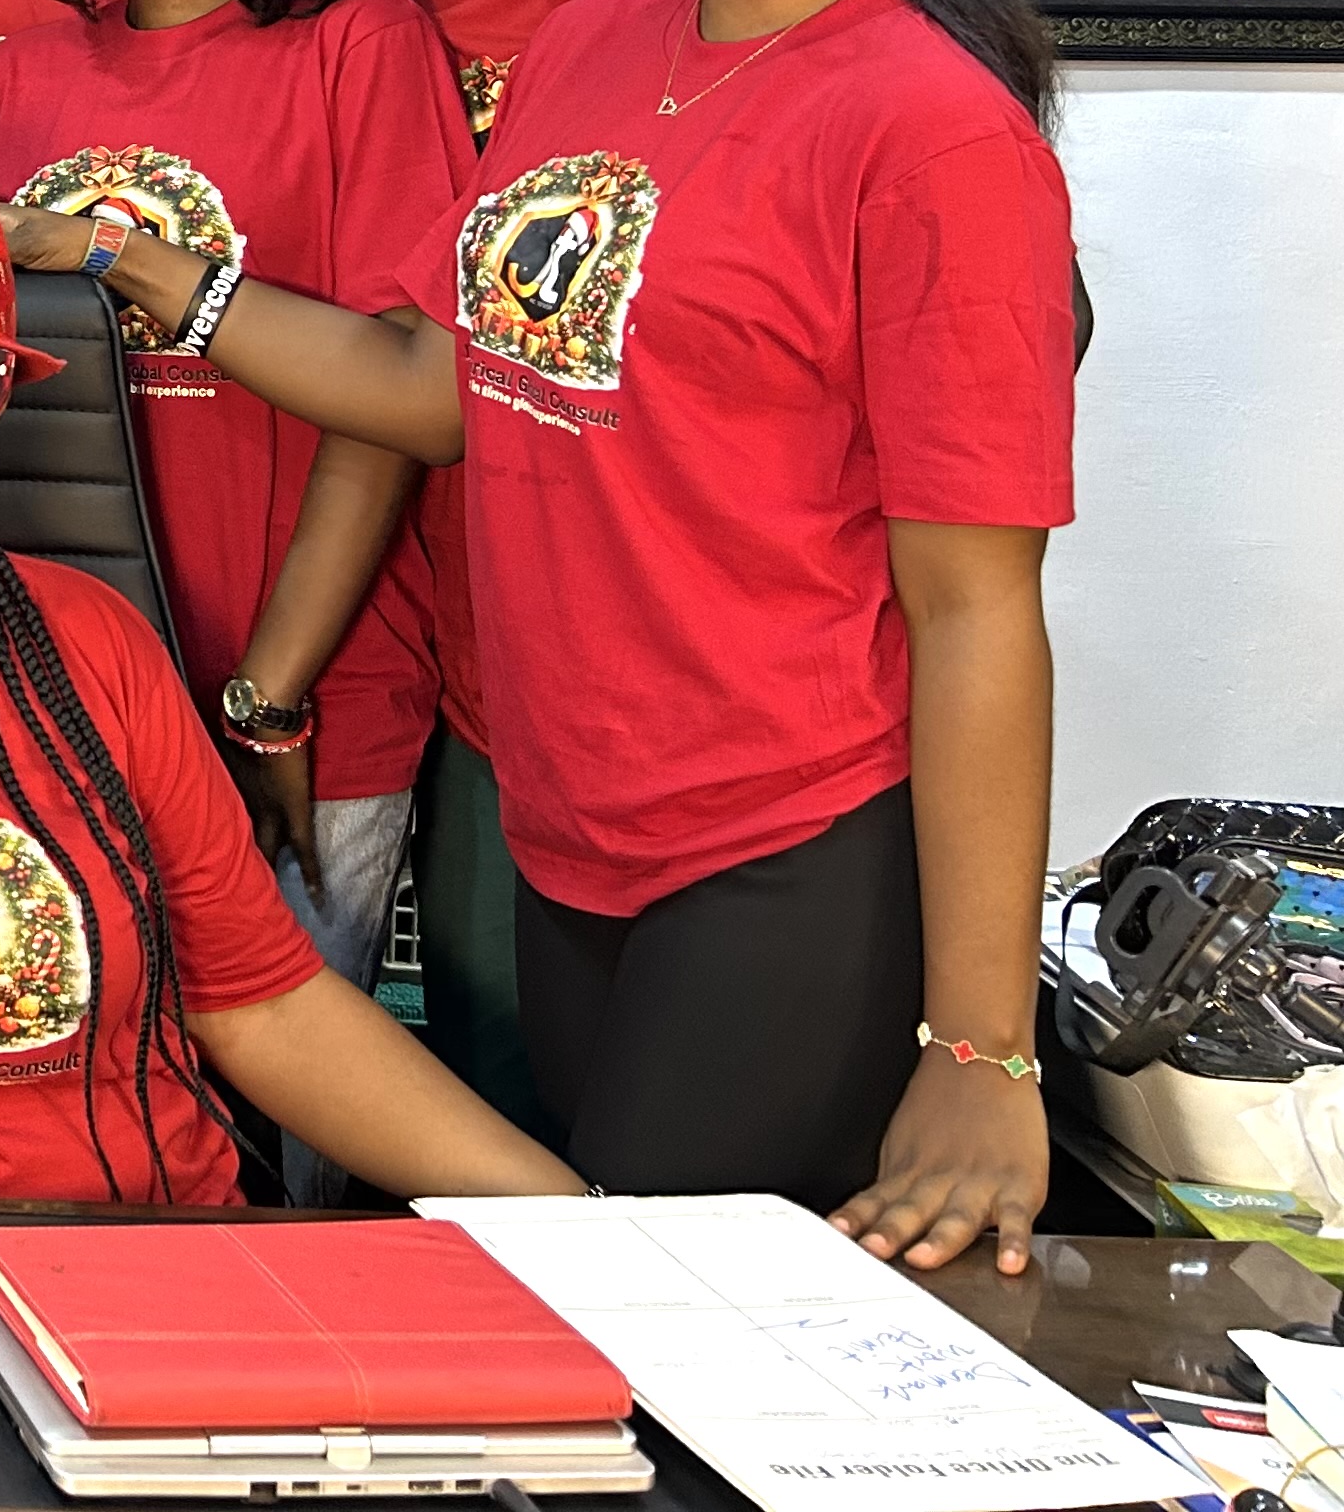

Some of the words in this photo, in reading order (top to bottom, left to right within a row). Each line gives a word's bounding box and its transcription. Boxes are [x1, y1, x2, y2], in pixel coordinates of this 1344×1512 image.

[146, 385, 216, 399] experience
[949, 1456, 1052, 1476] Office
[1053, 1449, 1120, 1469] The
[769, 1463, 836, 1481] File
[841, 1462, 948, 1479] Folder
